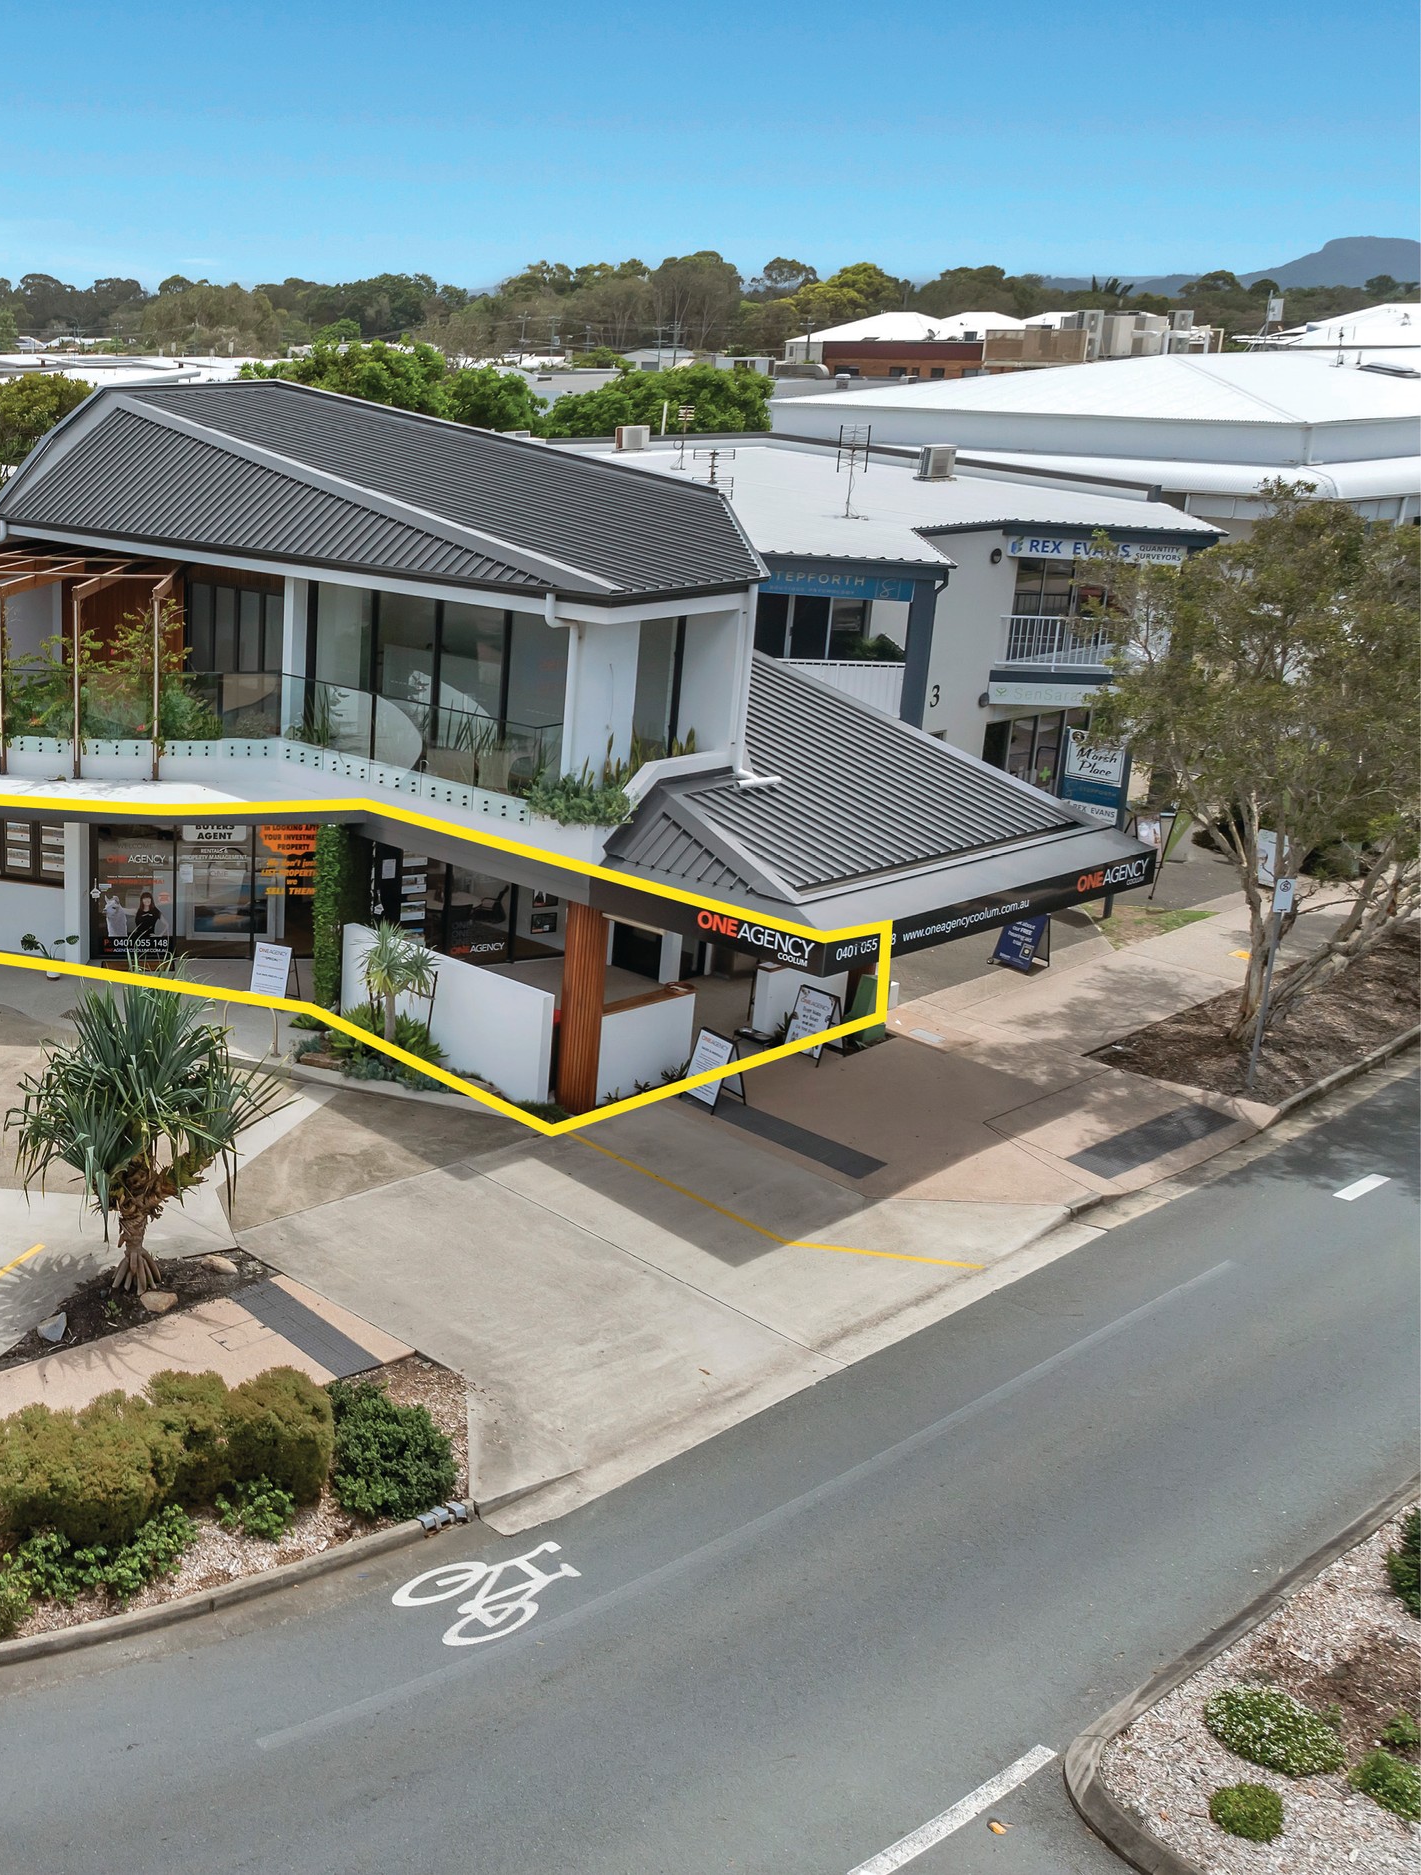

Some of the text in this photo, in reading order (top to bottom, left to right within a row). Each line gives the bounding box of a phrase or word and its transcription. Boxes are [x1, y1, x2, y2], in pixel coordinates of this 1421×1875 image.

[1029, 539, 1062, 554] REX
[1138, 544, 1180, 554] QUANTITY
[1135, 552, 1182, 562] SURVEYORS
[769, 570, 866, 587] TEPFORTH
[930, 684, 941, 707] 3
[1078, 760, 1112, 776] Place
[1090, 807, 1116, 818] EVANS
[197, 832, 233, 840] AGENT
[902, 899, 1030, 943] www.oneagencycoolum.com.au
[113, 939, 133, 947] 0401
[135, 939, 151, 947] 055
[154, 939, 168, 947] 148
[835, 943, 858, 961] 0401
[860, 939, 878, 953] 055
[777, 952, 809, 968] COOLUM
